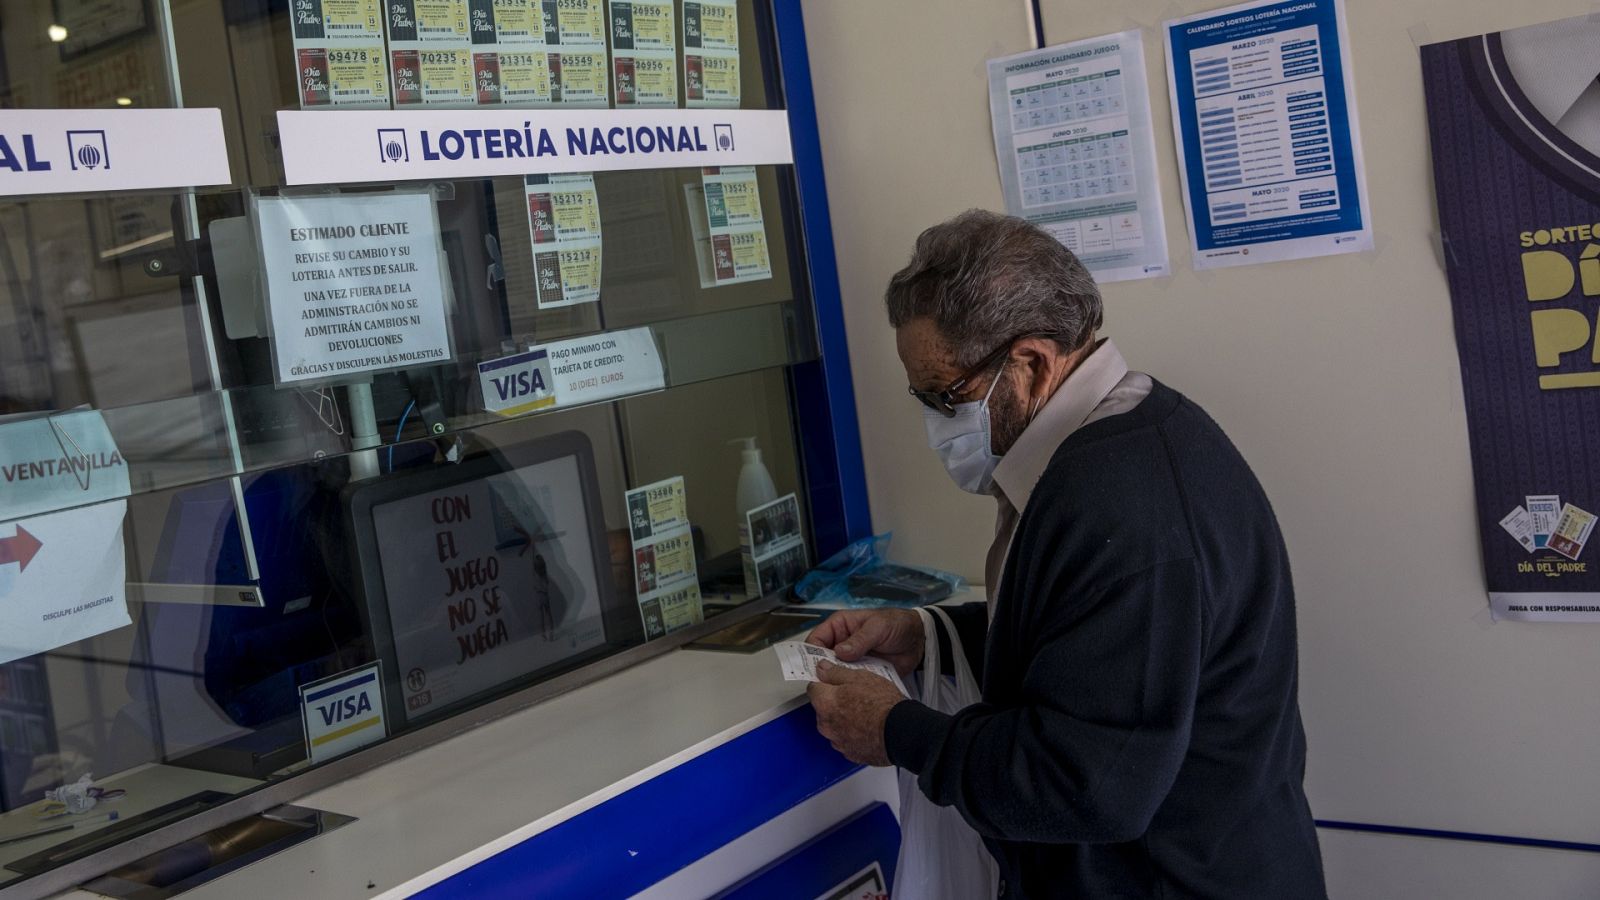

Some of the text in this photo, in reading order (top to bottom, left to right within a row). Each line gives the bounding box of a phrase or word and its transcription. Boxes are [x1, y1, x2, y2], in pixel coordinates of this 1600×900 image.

[298, 10, 321, 24] Padre
[393, 14, 415, 28] Padre
[473, 19, 494, 32] Padre
[1187, 21, 1225, 35] CALENDARIO
[1226, 15, 1254, 28] SORTEOS
[1255, 9, 1280, 21] LOTERÍA
[1282, 2, 1317, 15] NACIONAL
[1232, 38, 1275, 51] MARZO 2020
[329, 51, 367, 61] 69478
[421, 53, 456, 62] 70235
[500, 56, 532, 65] 21314
[562, 57, 592, 65] 65549
[1005, 44, 1120, 73] INFORMACIÓN CALENDARIO JUEGOS
[1046, 67, 1079, 78] MAYO 2020
[305, 78, 329, 91] Padre
[399, 78, 420, 90] Padre
[1238, 90, 1274, 102] ABRIL 2020
[420, 121, 708, 161] LOTERÍA NACIONAL
[1052, 127, 1087, 138] JUNIO 2020
[553, 194, 583, 205] 15212
[1252, 186, 1290, 197] MAYO 2020
[290, 222, 409, 241] ESTIMADO CLIENTE
[295, 246, 410, 264] REVISE SU CAMBIO Y SU
[292, 263, 418, 282] LOTERIA ANTES DE SALIR.
[304, 283, 411, 302] UNA VEZ FUERA DE LA
[301, 299, 418, 320] ADMINISTRACIÓN NO SE
[304, 315, 420, 338] ADMITIRÁN CAMBIOS NI
[329, 334, 403, 352] DEVOLUCIONES
[551, 340, 616, 360] PAGO MINIMO CON
[290, 348, 443, 376] GRACIAS Y DISCULPEN LAS MOLESTIAS
[553, 355, 625, 376] TARJETA DE CREDITO:
[489, 368, 546, 401] VISA
[570, 372, 624, 391] 10 (DIEZ) EUROS
[2, 450, 122, 482] VENTANILLA
[432, 494, 471, 524] CON
[436, 531, 460, 563] EL
[1518, 561, 1587, 572] DÍA DEL PADRE
[446, 556, 499, 597] JUEGO
[43, 596, 114, 621] DISCULPE LAS MOLESTIAS
[448, 586, 502, 632] NO SE
[457, 618, 508, 665] JUEGA
[315, 691, 371, 726] VISA
